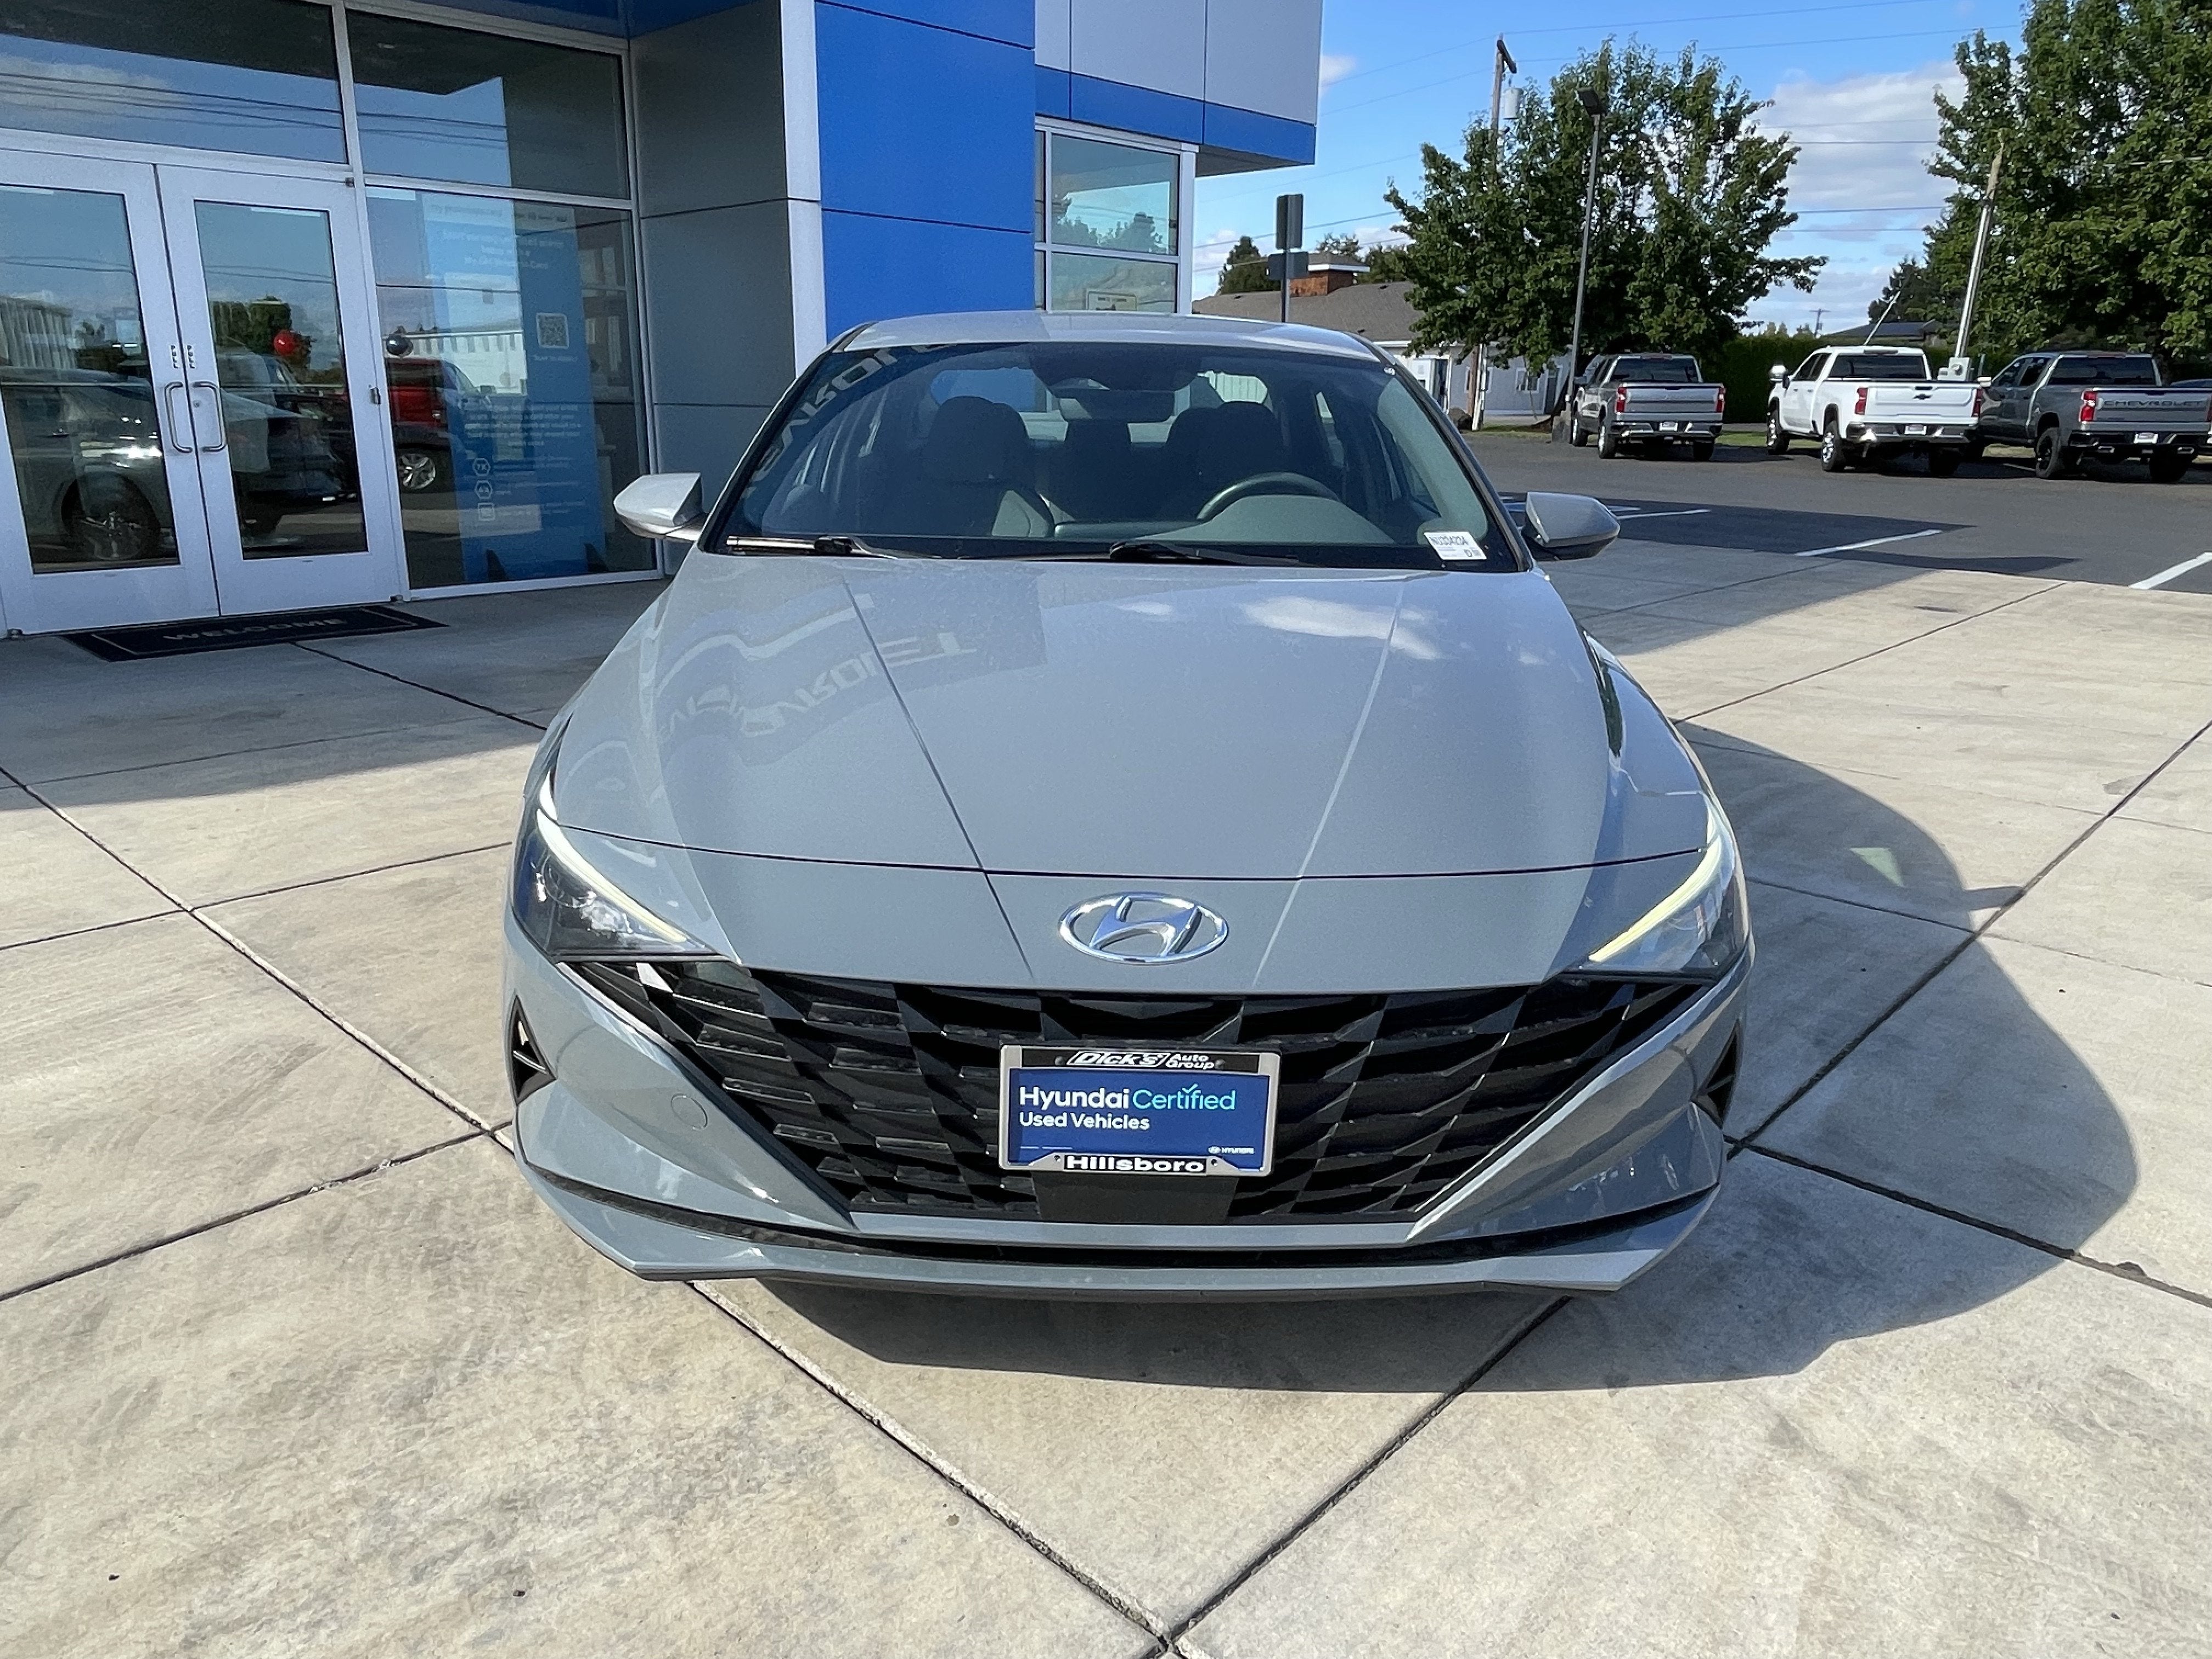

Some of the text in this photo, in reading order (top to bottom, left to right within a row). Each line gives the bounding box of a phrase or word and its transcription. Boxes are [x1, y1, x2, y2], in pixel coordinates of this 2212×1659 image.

[170, 345, 179, 369] PULL
[187, 345, 195, 369] PULL
[163, 619, 347, 640] WELCOME
[1165, 1060, 1215, 1069] Group
[1170, 1053, 1209, 1062] Auto
[1019, 1084, 1236, 1110] Hyundai Certified
[1019, 1111, 1150, 1130] Used Vehicles
[1067, 1155, 1206, 1172] Hillsboro
